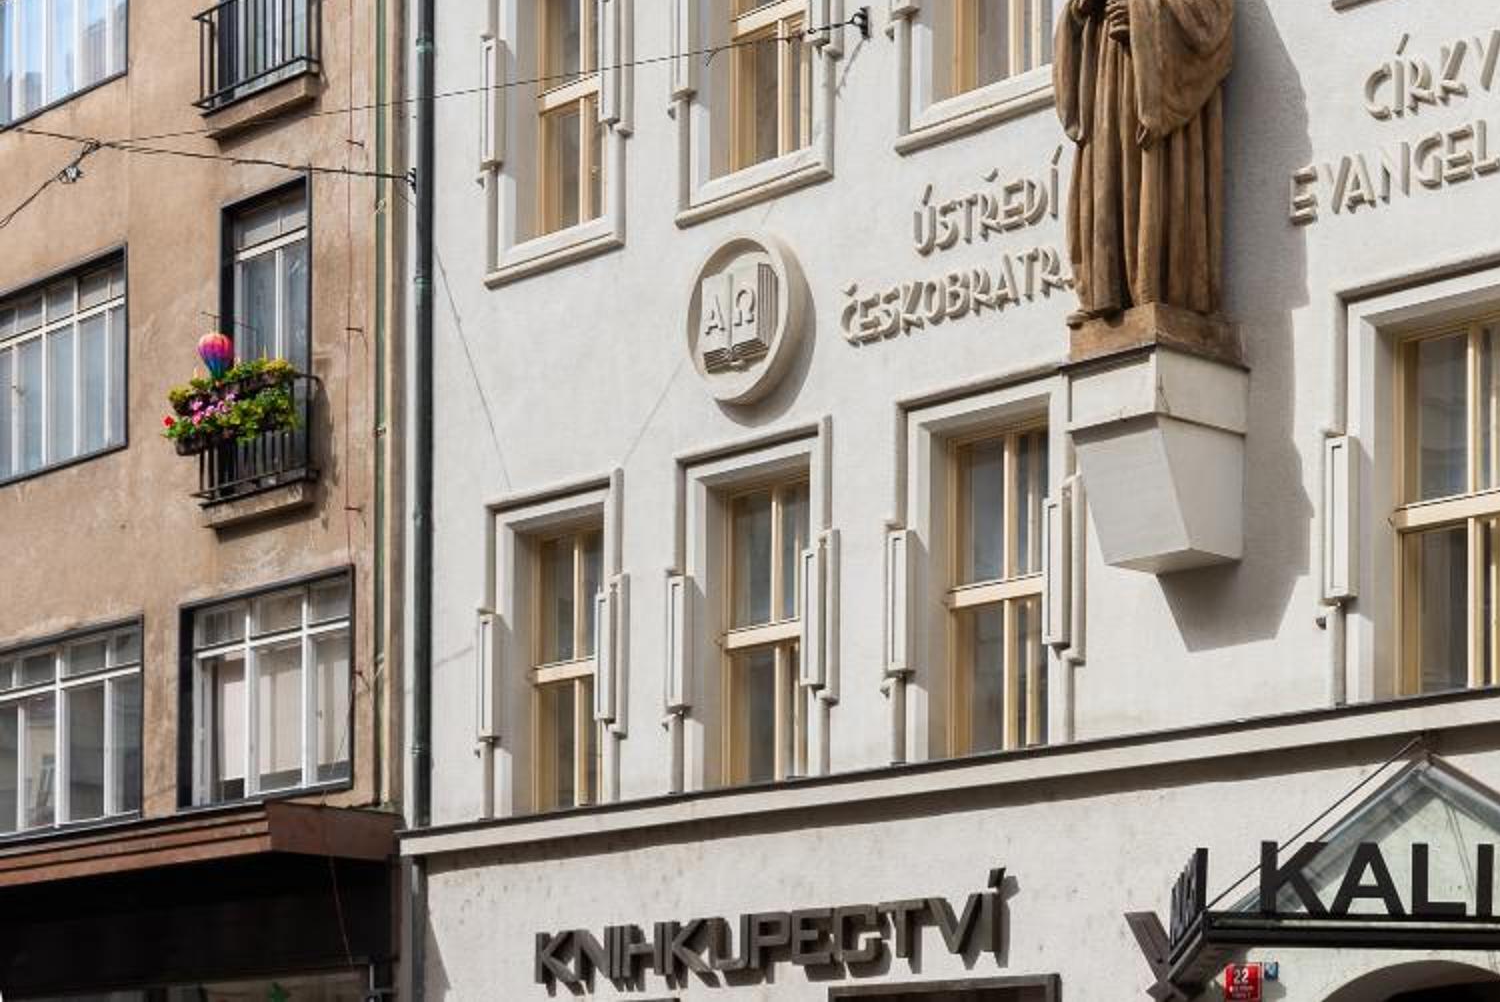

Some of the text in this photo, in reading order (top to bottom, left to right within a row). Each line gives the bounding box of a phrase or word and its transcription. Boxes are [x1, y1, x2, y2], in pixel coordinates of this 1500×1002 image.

[912, 144, 1063, 258] ÚSTŘEDÍ
[840, 246, 1076, 349] ČESKOBRATR
[534, 866, 1012, 988] KNIHKUPECTVÍ
[1233, 966, 1249, 984] 22
